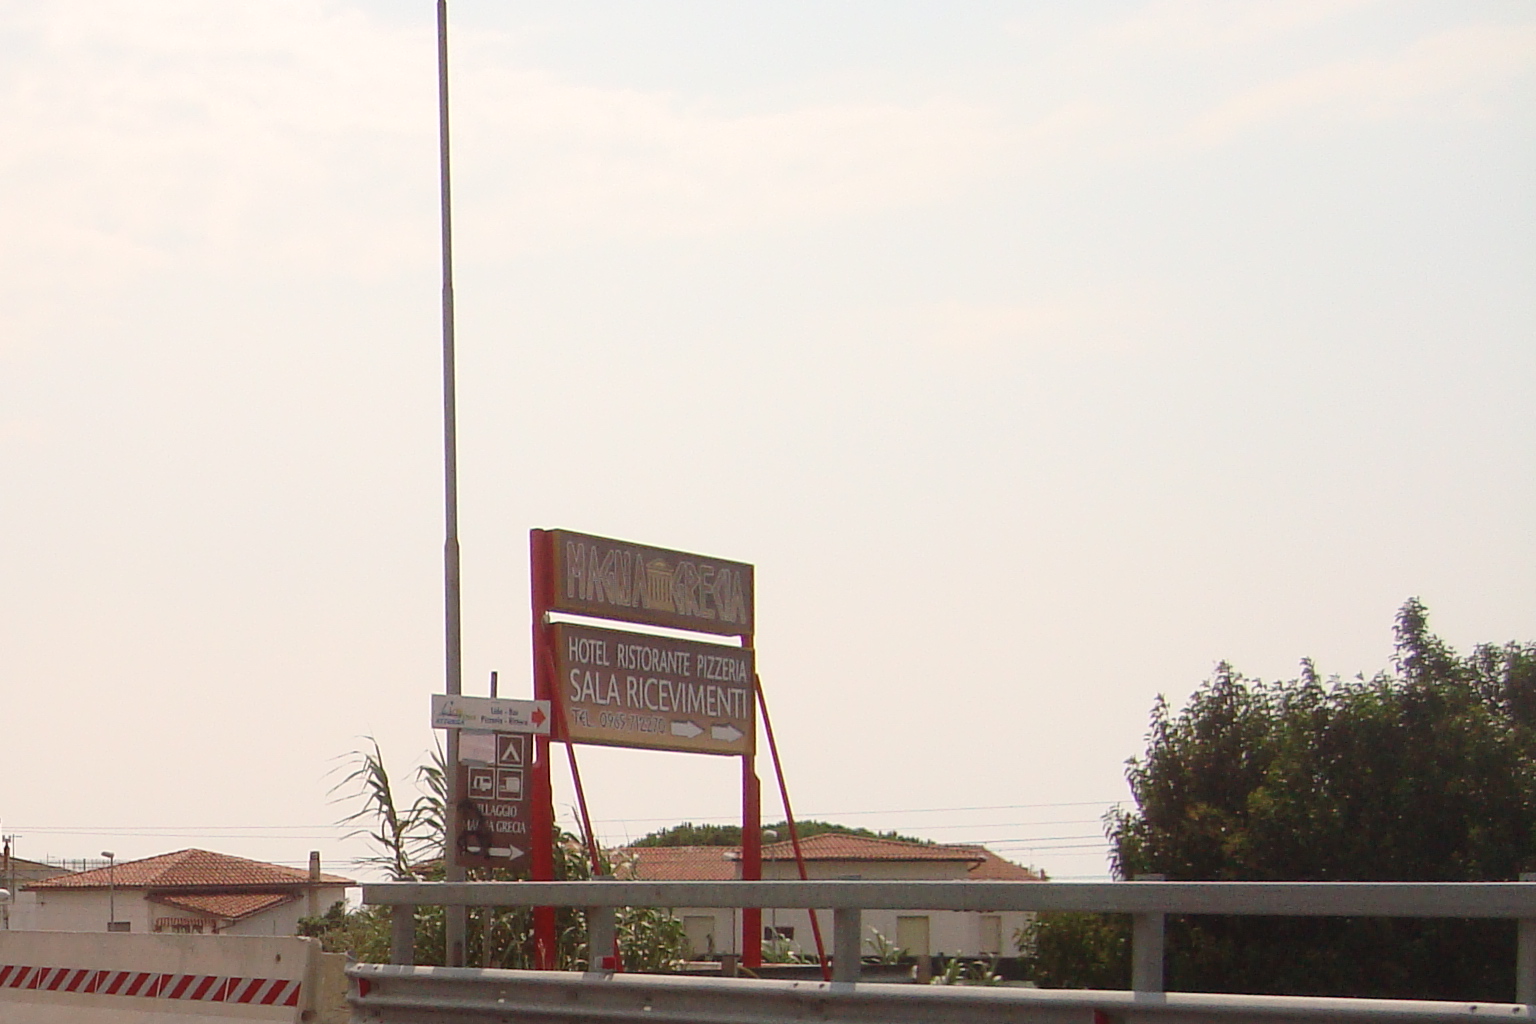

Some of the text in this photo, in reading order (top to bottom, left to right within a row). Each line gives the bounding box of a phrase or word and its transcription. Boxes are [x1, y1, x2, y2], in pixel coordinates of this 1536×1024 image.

[566, 541, 747, 625] MAGNA GRECIA
[568, 636, 747, 682] HOTEL RISTORANTE PIZZERIA
[569, 668, 747, 719] SALA RICEVIMENTI
[496, 821, 526, 834] GRECIA
